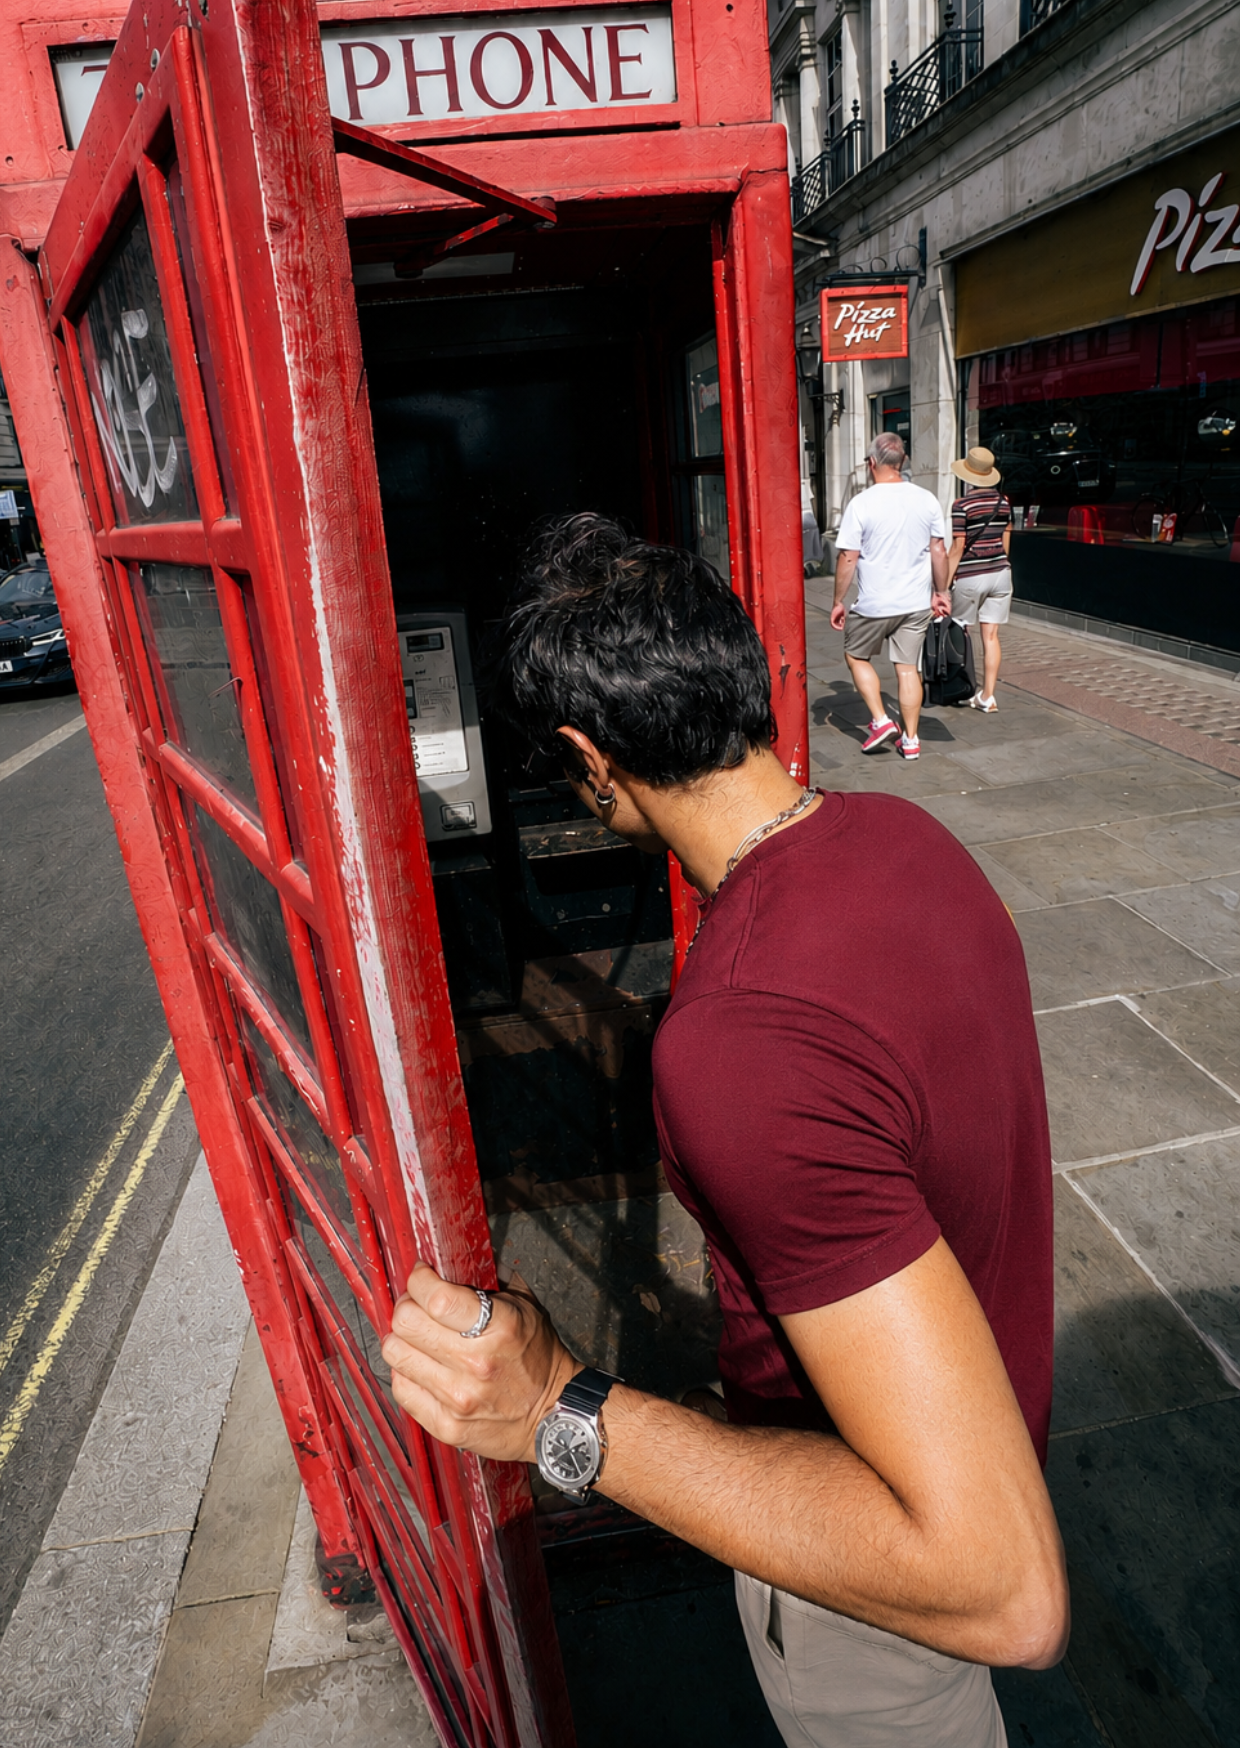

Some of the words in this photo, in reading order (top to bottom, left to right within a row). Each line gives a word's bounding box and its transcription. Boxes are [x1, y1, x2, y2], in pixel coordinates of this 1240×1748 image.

[338, 23, 652, 121] PHONE
[1130, 172, 1240, 296] Piz
[834, 301, 897, 330] Pizza
[844, 321, 892, 347] Hut
